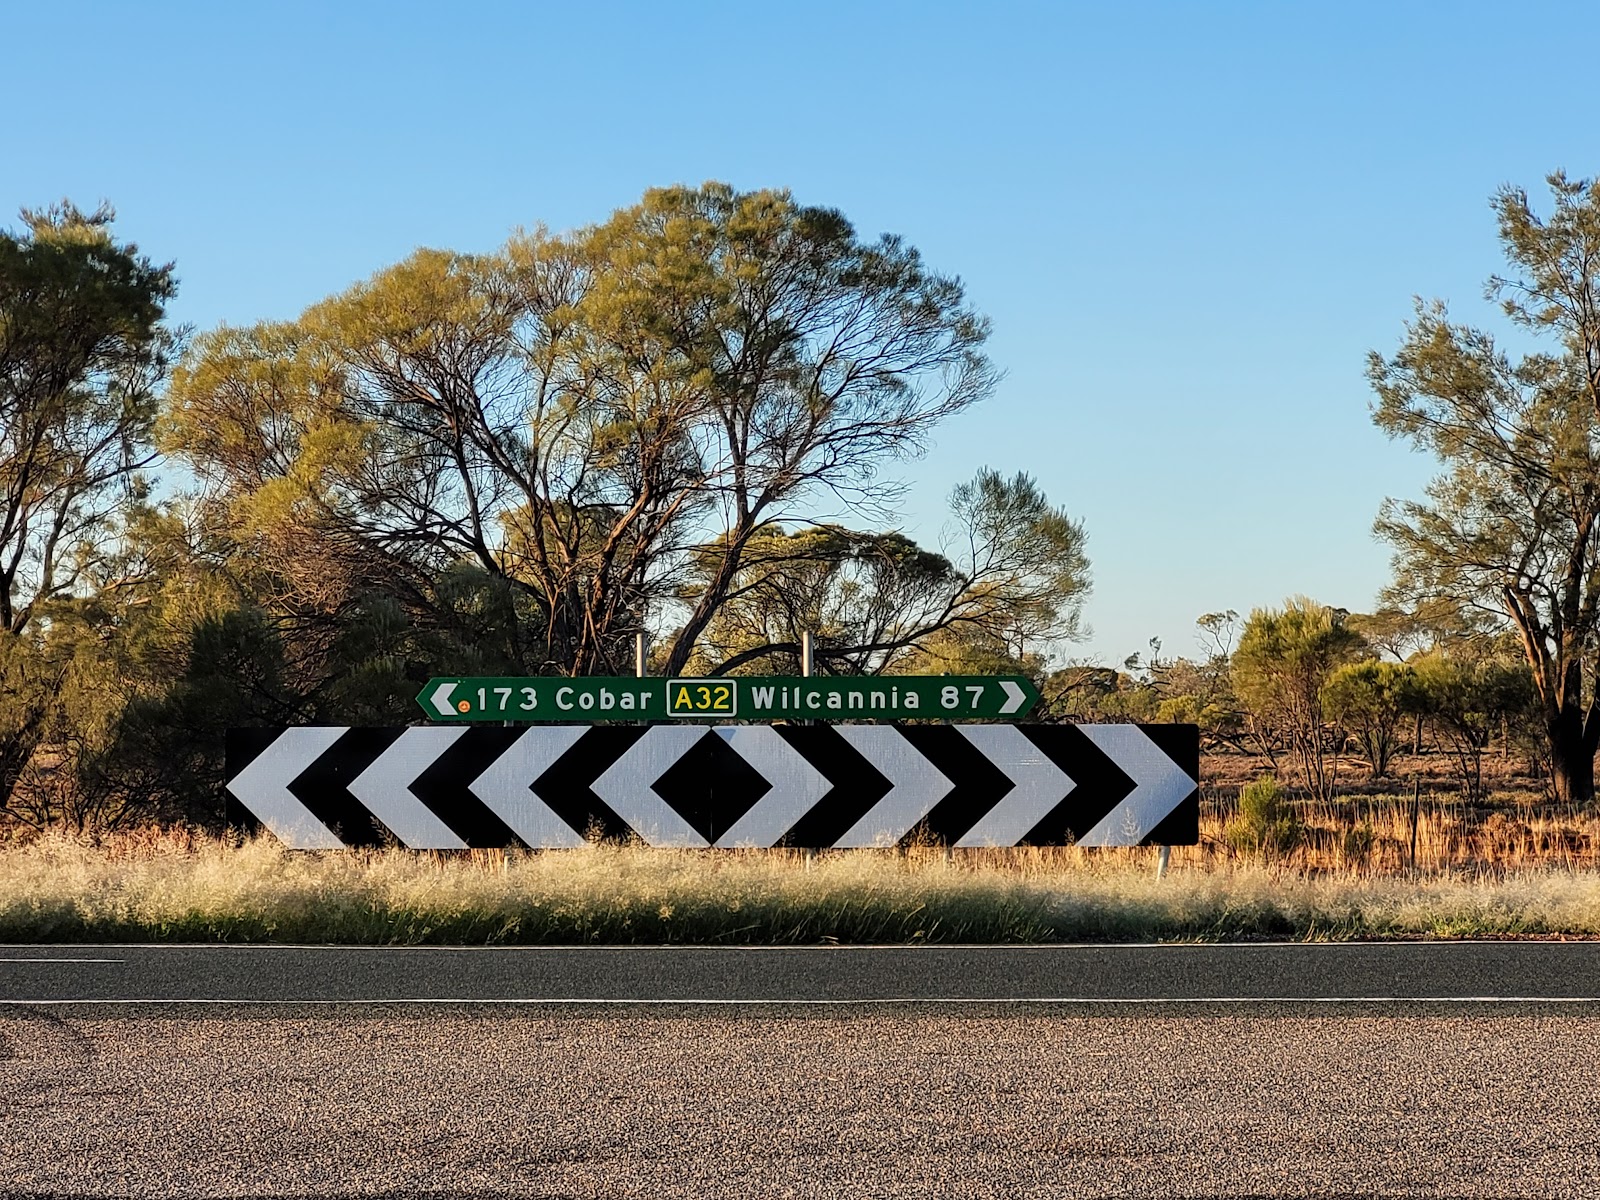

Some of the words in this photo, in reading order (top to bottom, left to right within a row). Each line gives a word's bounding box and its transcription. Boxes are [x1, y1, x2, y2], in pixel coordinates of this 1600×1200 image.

[477, 687, 538, 710] 173
[555, 687, 652, 710] Cobar
[674, 686, 730, 710] A32
[751, 686, 919, 709] Wilcannia
[940, 686, 984, 709] 87
